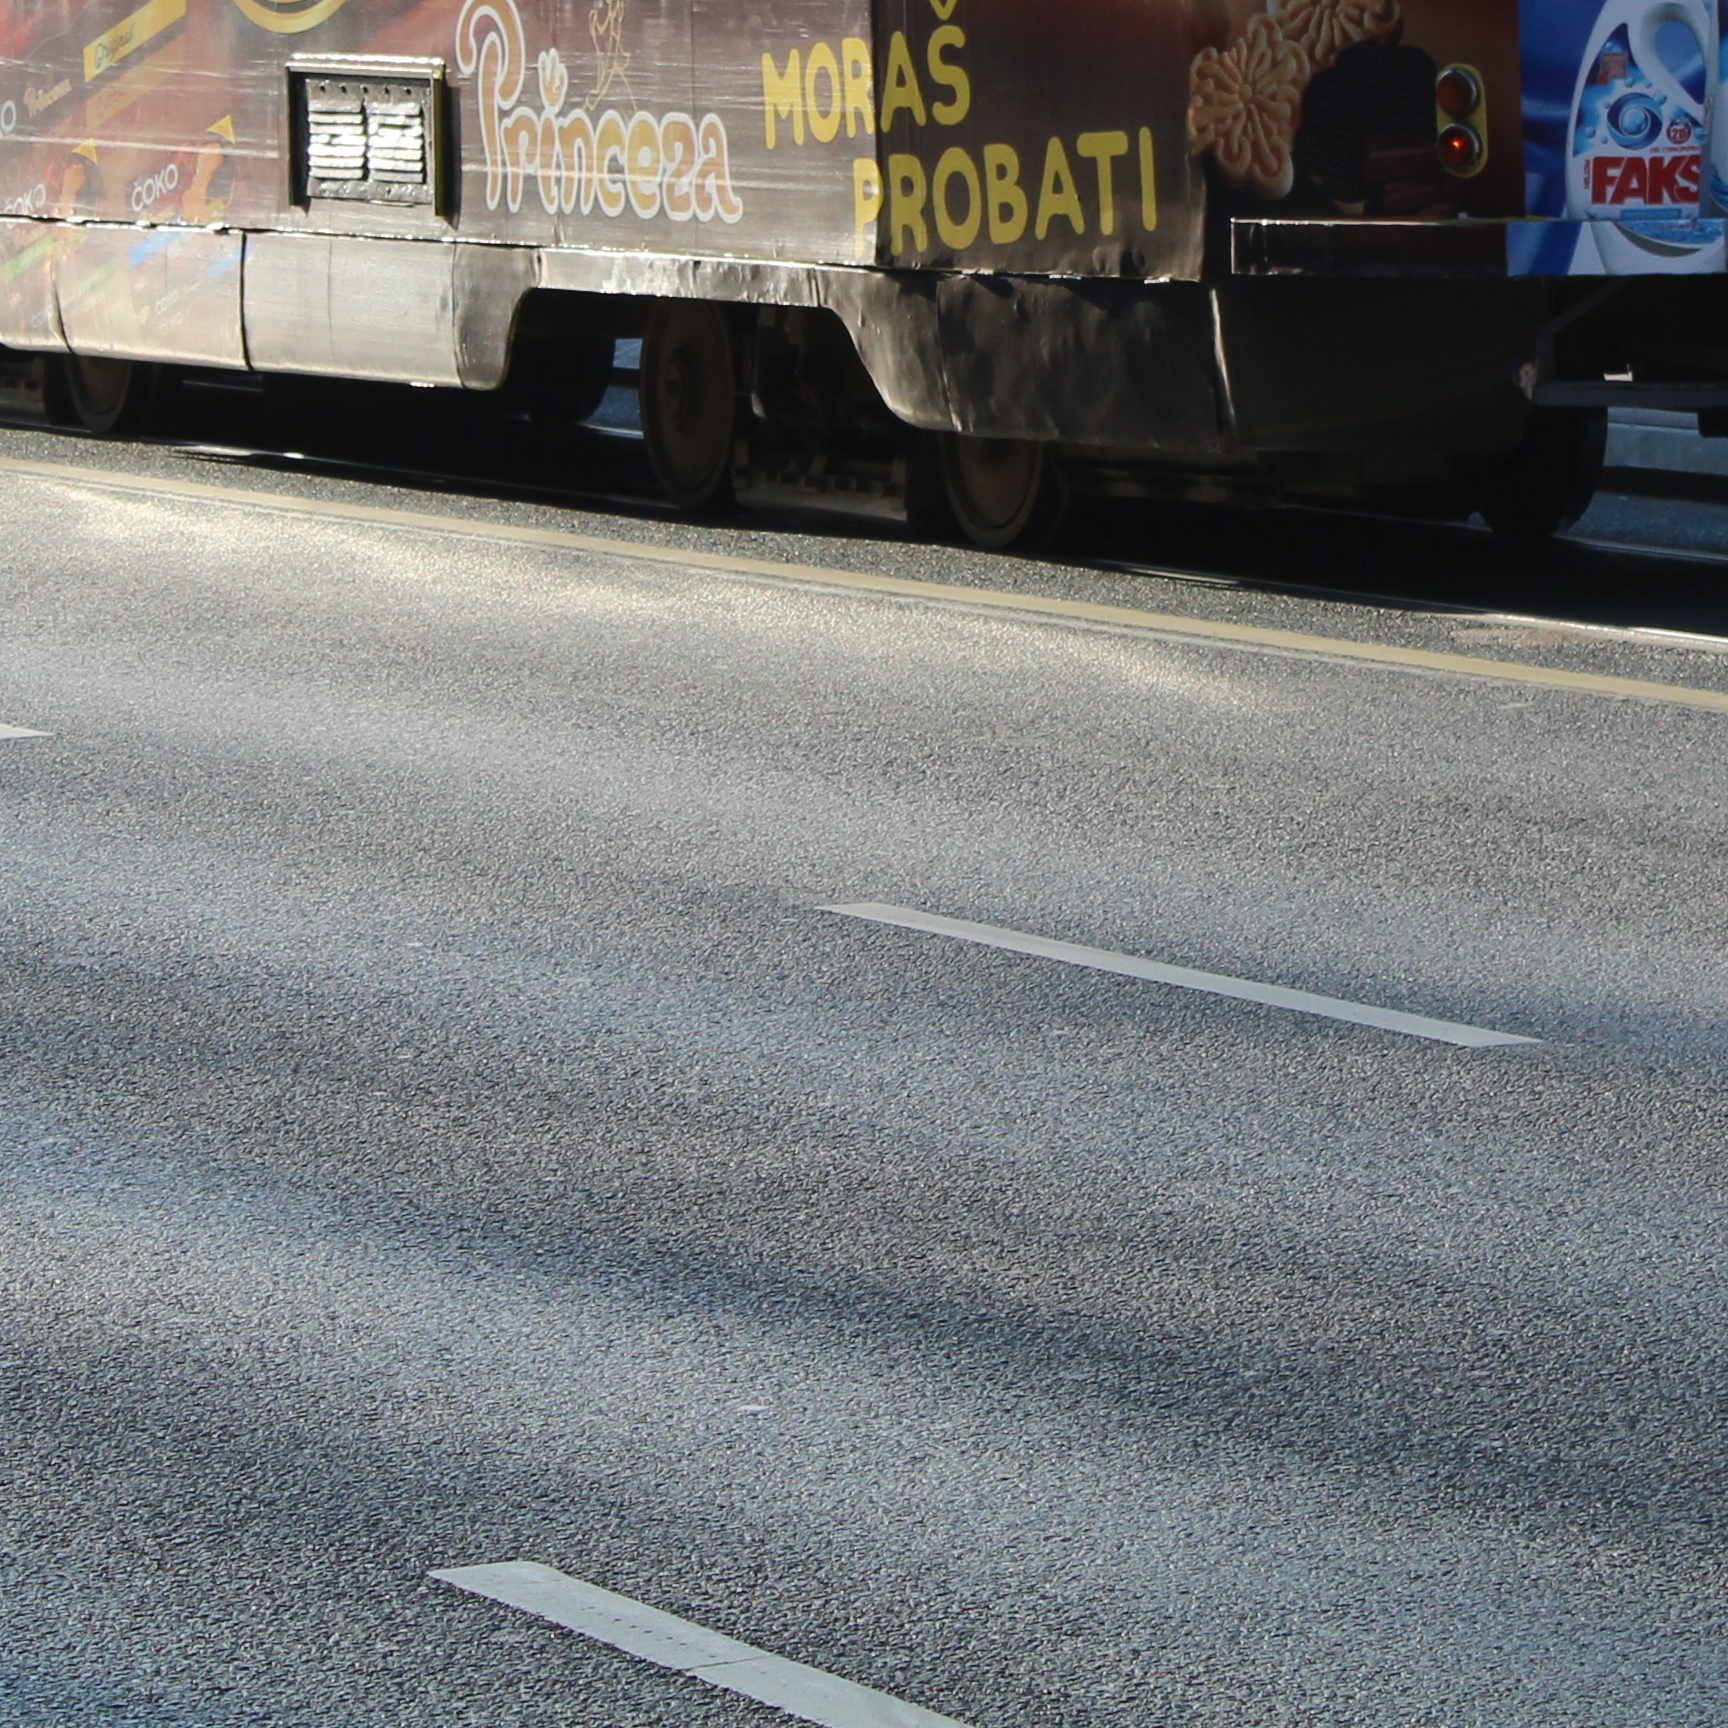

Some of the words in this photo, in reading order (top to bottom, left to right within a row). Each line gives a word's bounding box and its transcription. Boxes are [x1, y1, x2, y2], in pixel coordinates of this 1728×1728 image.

[130, 162, 180, 213] ČOKO
[852, 127, 1157, 259] PROBATI
[1591, 154, 1701, 205] FAKS
